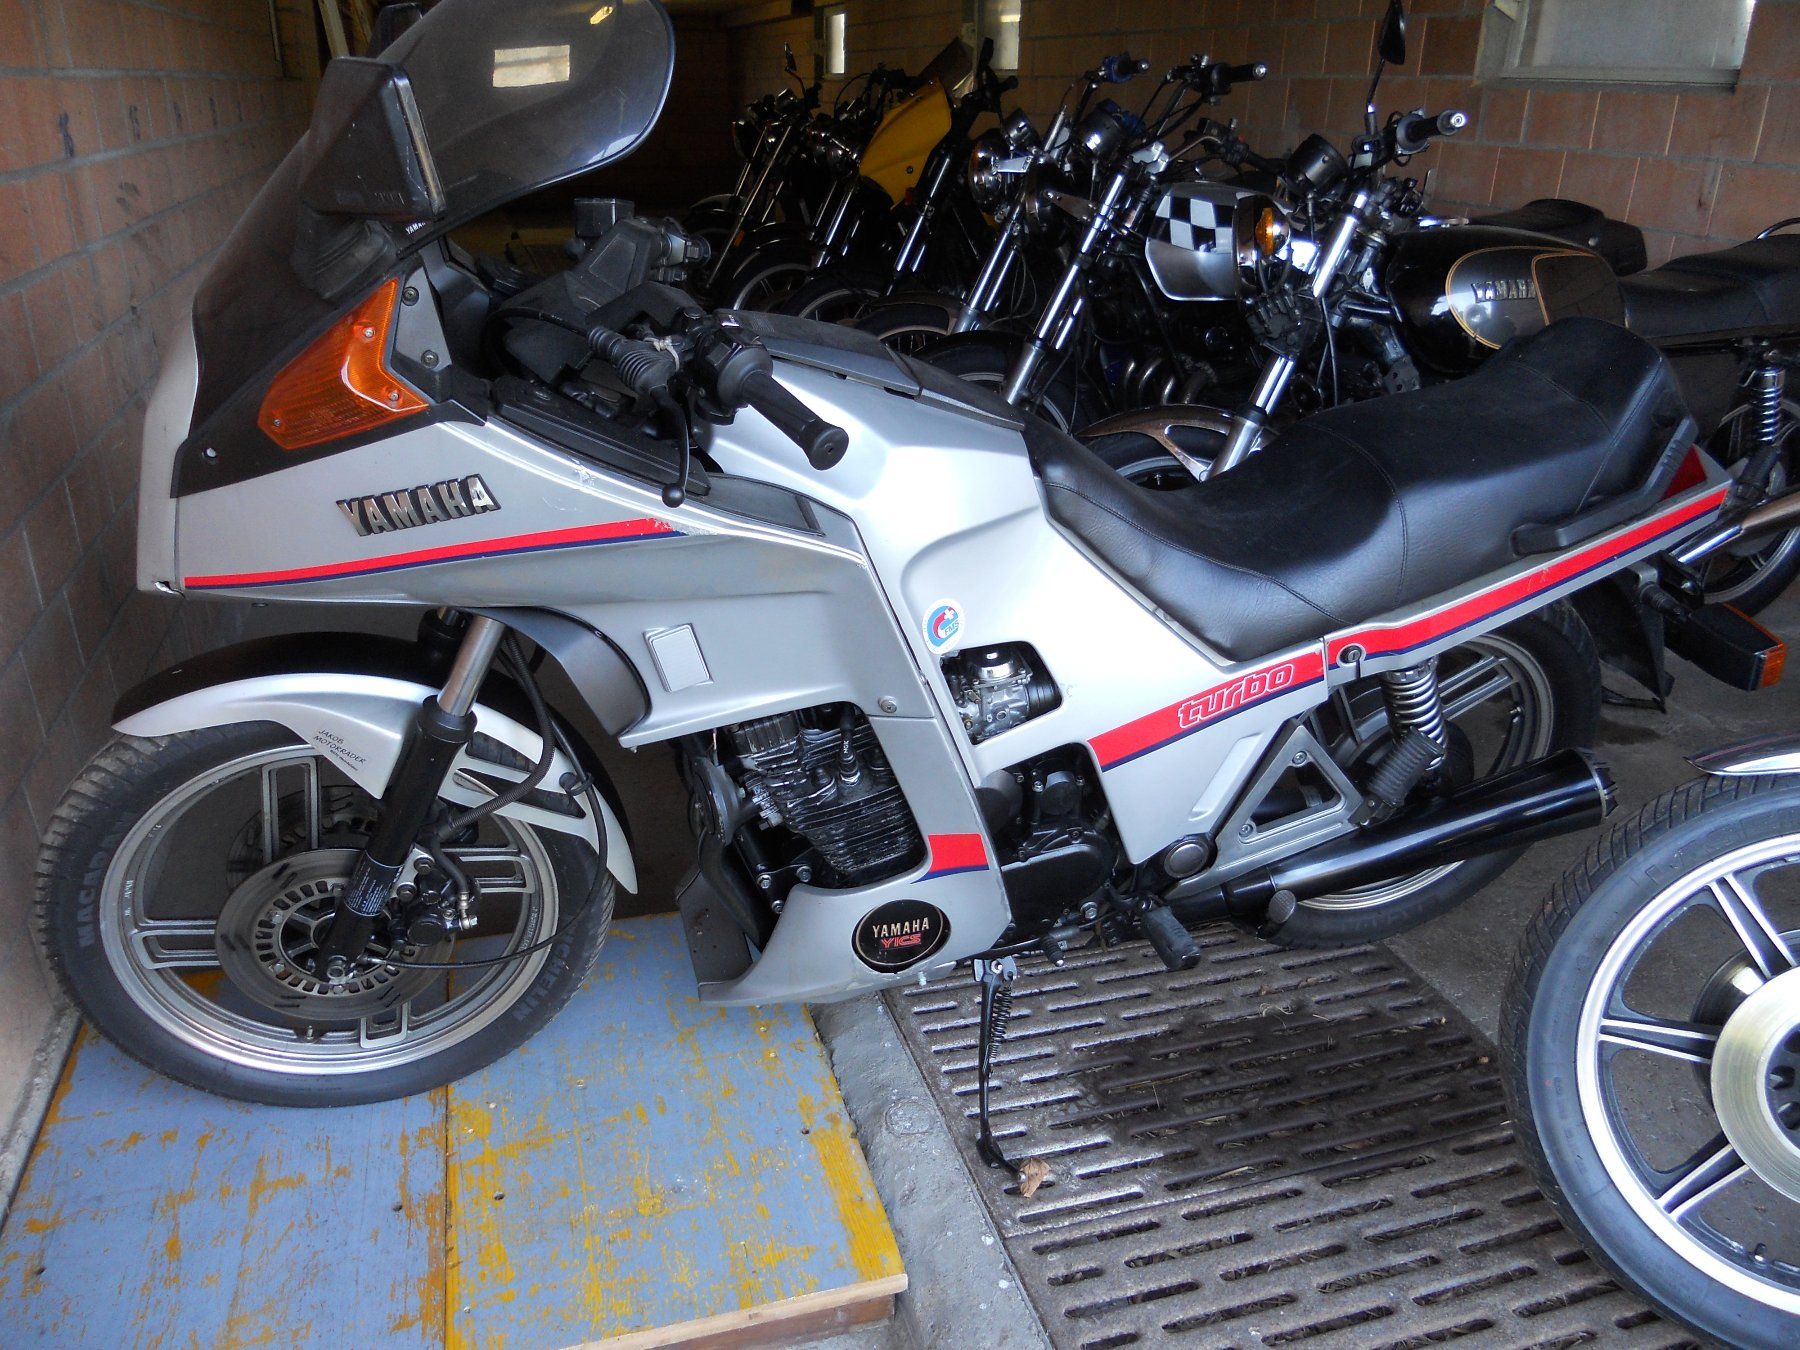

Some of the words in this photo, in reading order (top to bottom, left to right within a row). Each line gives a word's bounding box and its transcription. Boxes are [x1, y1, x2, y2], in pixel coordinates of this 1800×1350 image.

[336, 473, 502, 537] YAMAHA
[1177, 664, 1295, 728] turbo
[318, 729, 345, 745] JAKOB
[872, 917, 930, 938] YAMAHA
[880, 933, 922, 949] YICS
